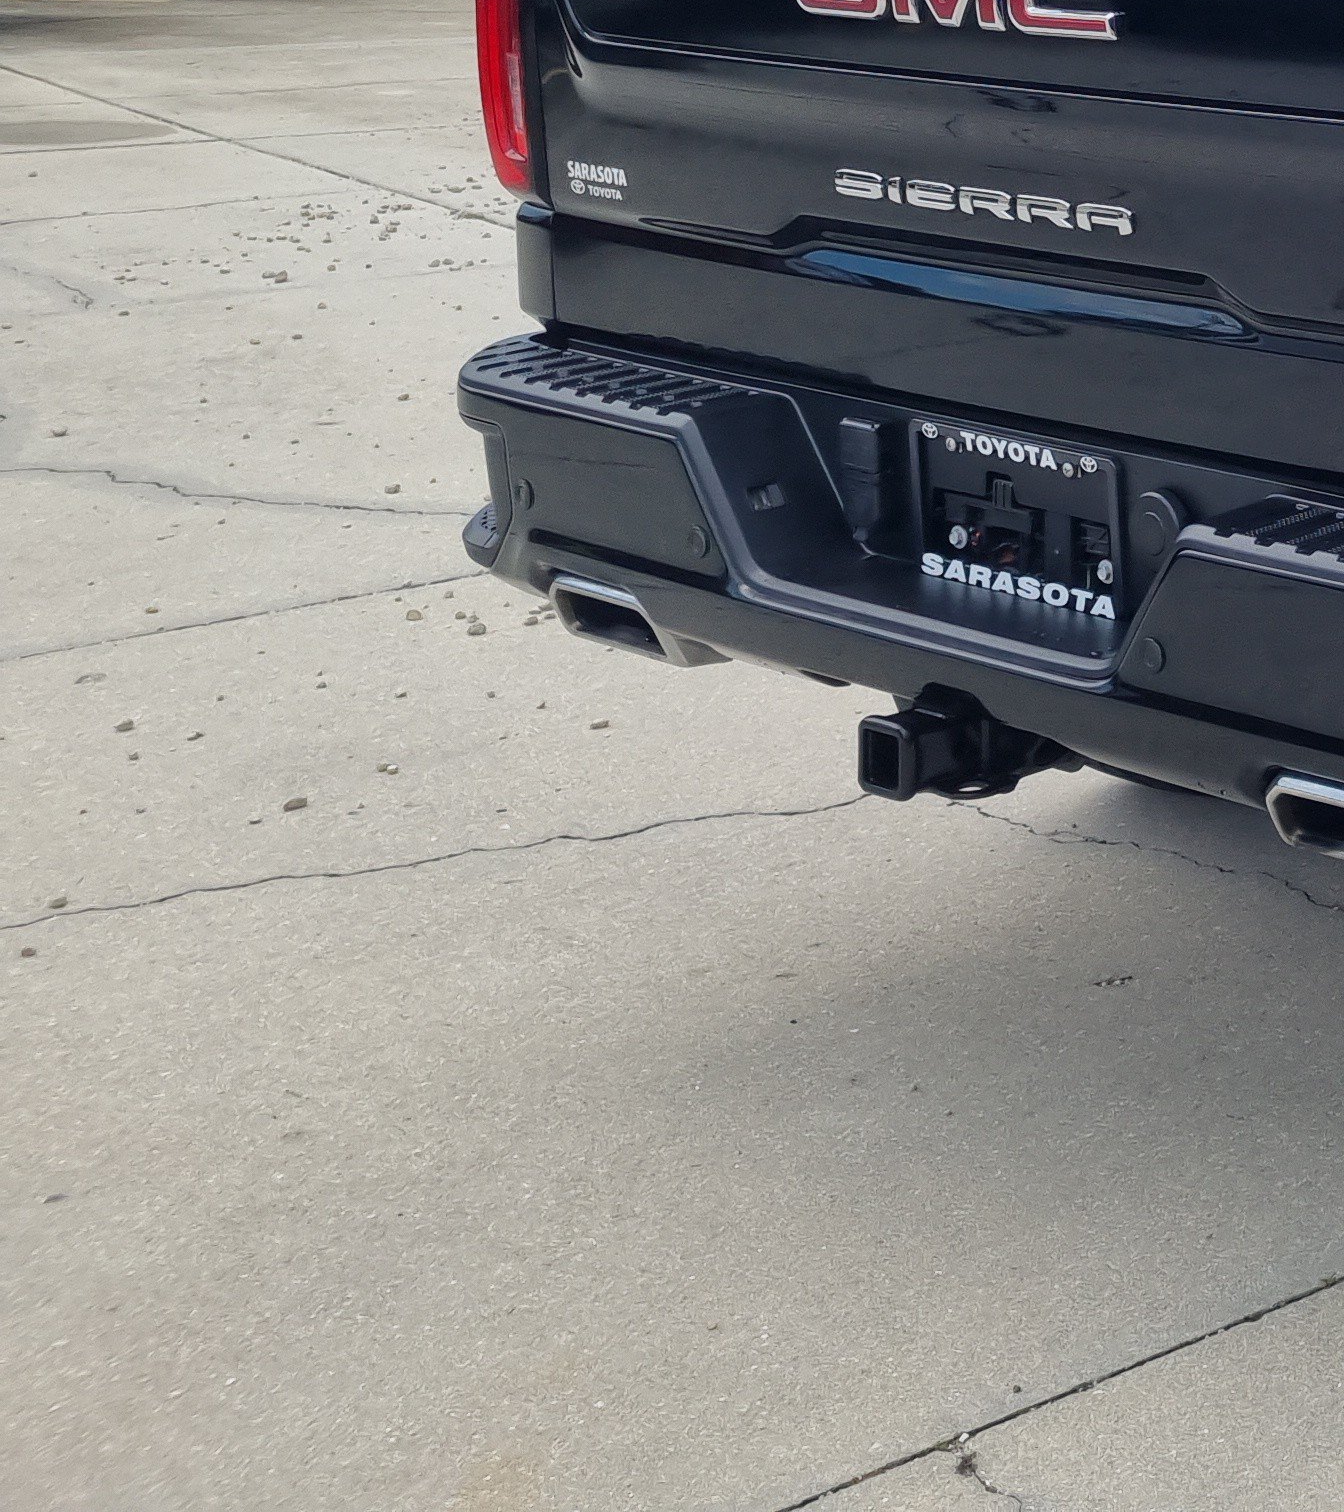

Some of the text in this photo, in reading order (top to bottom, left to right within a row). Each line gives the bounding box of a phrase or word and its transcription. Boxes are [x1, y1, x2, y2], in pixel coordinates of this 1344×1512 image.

[567, 160, 627, 187] SARASOTA
[587, 184, 623, 201] TOYOTA
[834, 168, 1136, 236] SIERRA
[959, 430, 1058, 470] TOYOTA
[920, 552, 1116, 620] SARASOTA
